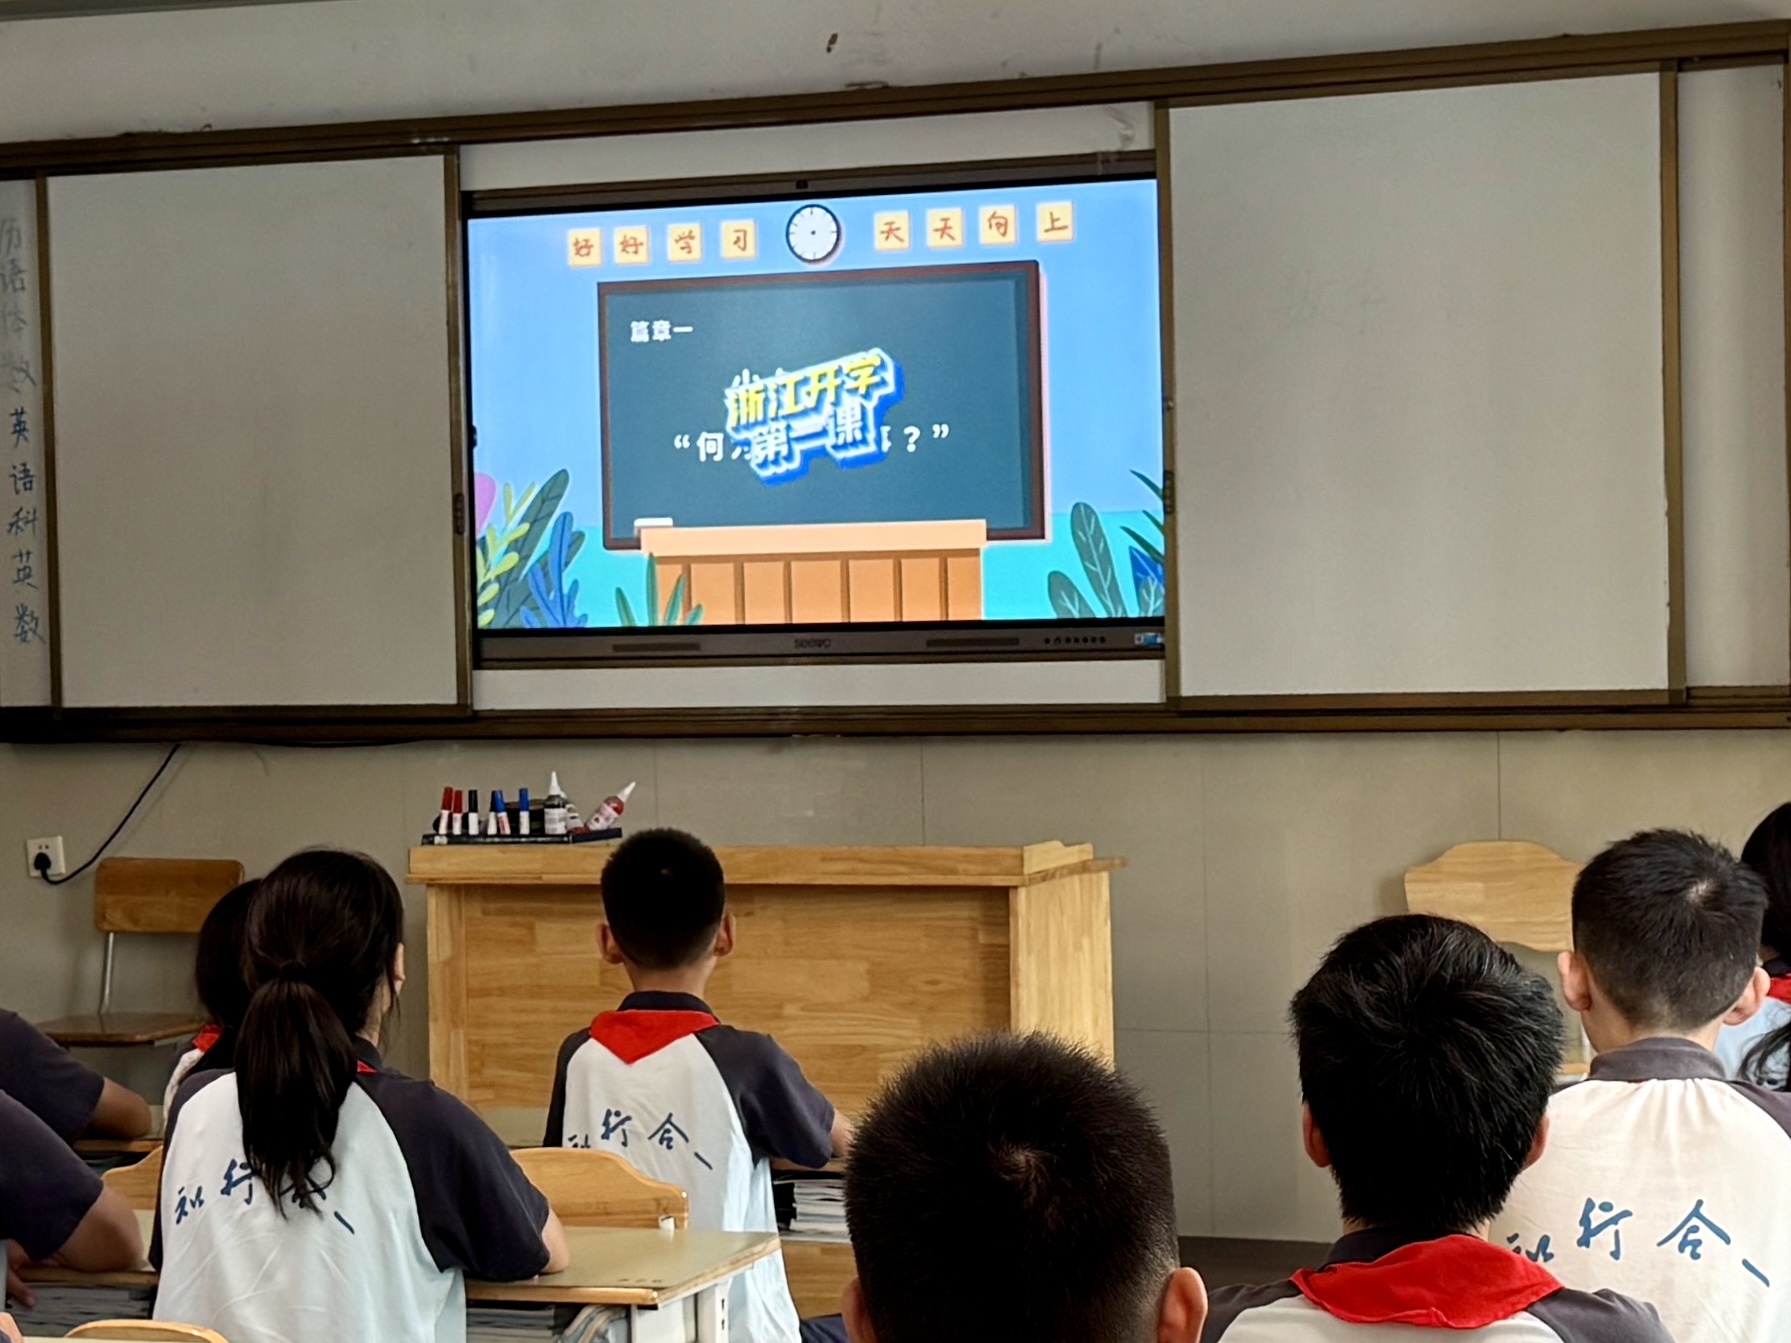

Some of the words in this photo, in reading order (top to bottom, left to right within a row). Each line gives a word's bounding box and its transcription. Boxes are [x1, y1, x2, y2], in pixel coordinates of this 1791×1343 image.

[879, 209, 1069, 244] 天天向上
[571, 227, 748, 259] 好好学习
[629, 319, 694, 343] 篇章一
